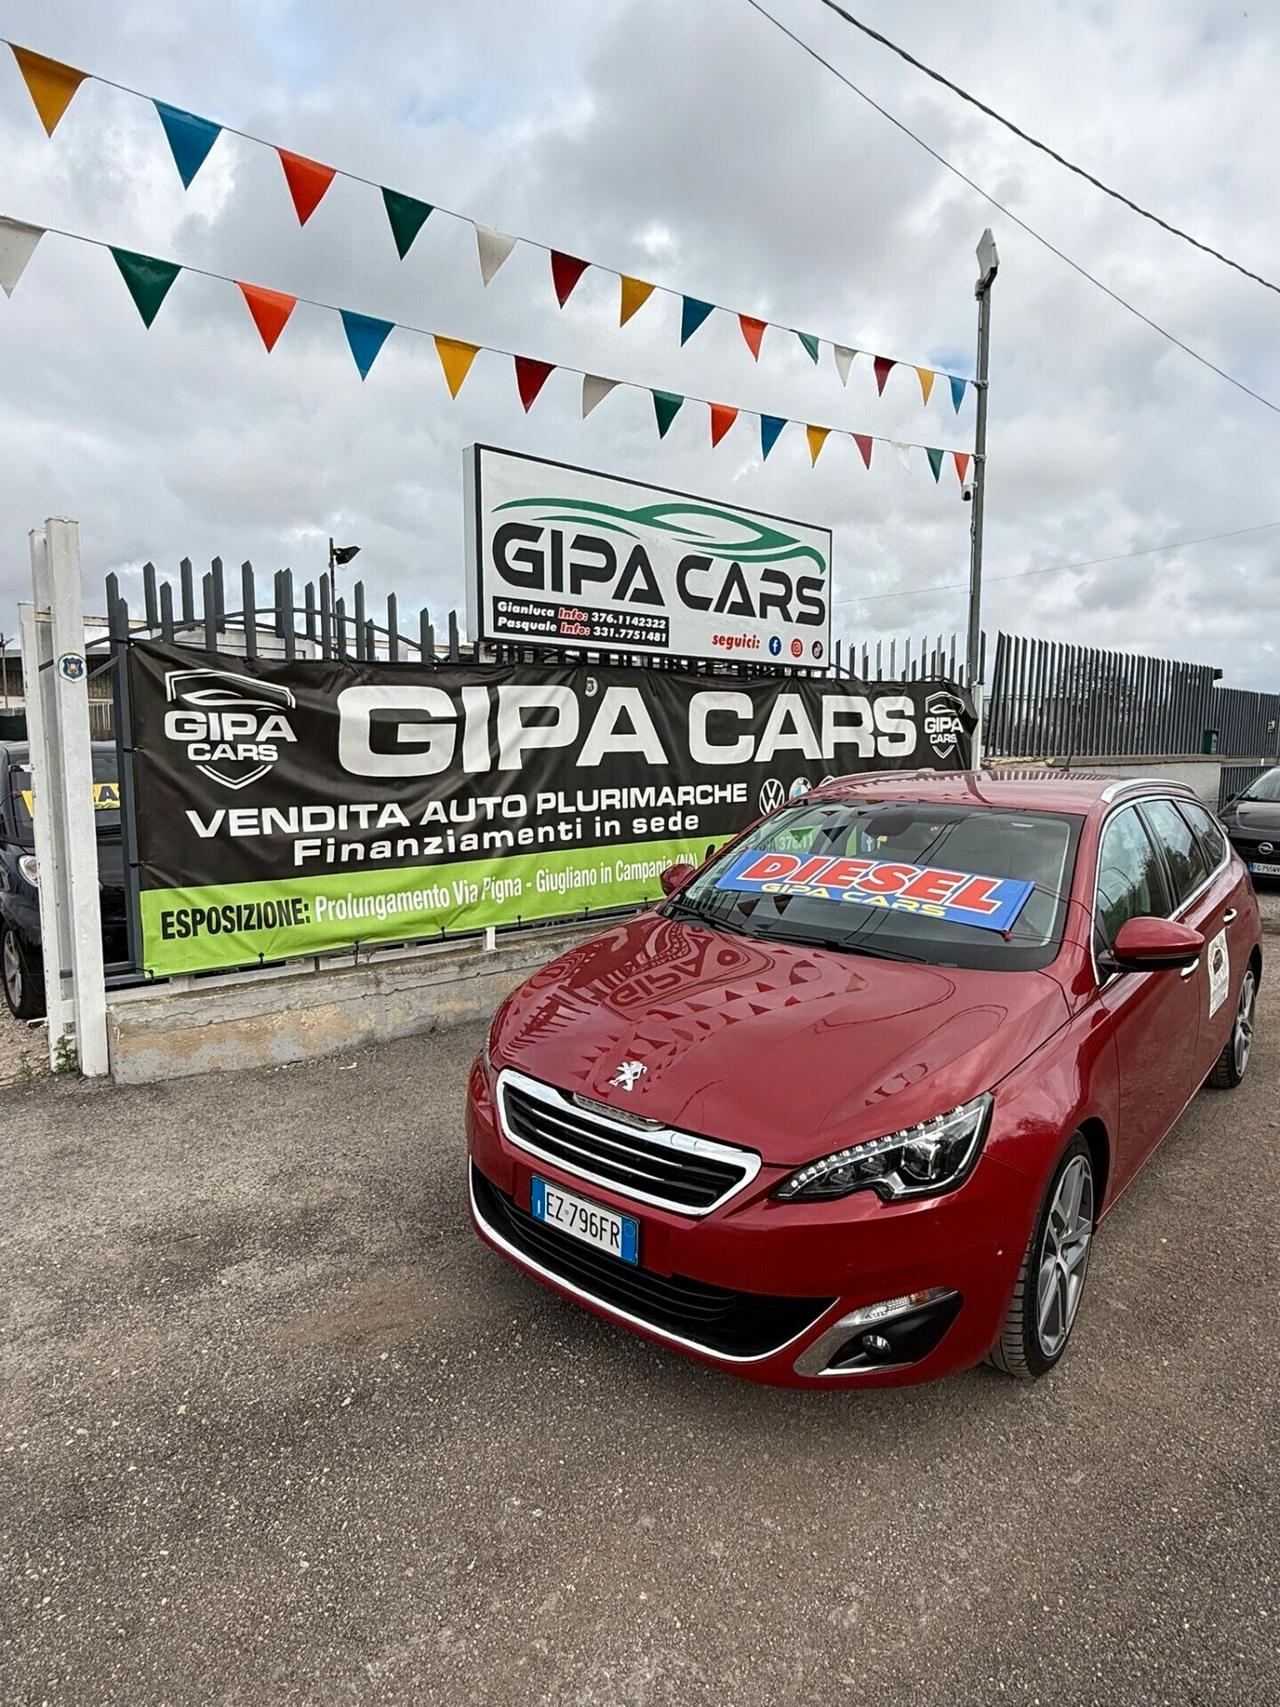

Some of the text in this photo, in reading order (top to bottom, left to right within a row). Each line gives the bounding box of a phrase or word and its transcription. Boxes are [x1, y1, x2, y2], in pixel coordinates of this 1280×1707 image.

[492, 522, 826, 627] GIPA CARS
[497, 601, 666, 629] Gianluca Info: 376.1142322
[498, 616, 667, 642] Pasquale Info: 331.7751481
[712, 633, 760, 650] seguici:
[164, 710, 298, 742] GIPA
[337, 685, 917, 777] GIPA CARS
[924, 717, 964, 733] GIPA
[929, 733, 958, 744] CARS
[187, 743, 278, 761] CARS
[185, 783, 748, 838] VENDITA AUTO PLURIMARCHE
[293, 811, 700, 866] Finanziamenti in sede
[736, 852, 1004, 915] DIESEL
[761, 882, 948, 917] GIPA CARS
[161, 897, 311, 940] ESPOSIZIONE:
[315, 883, 450, 922] Prolungamento
[452, 880, 478, 904] Via
[481, 877, 522, 904] Pigna
[536, 867, 597, 896] Giugliano
[600, 864, 613, 885] in
